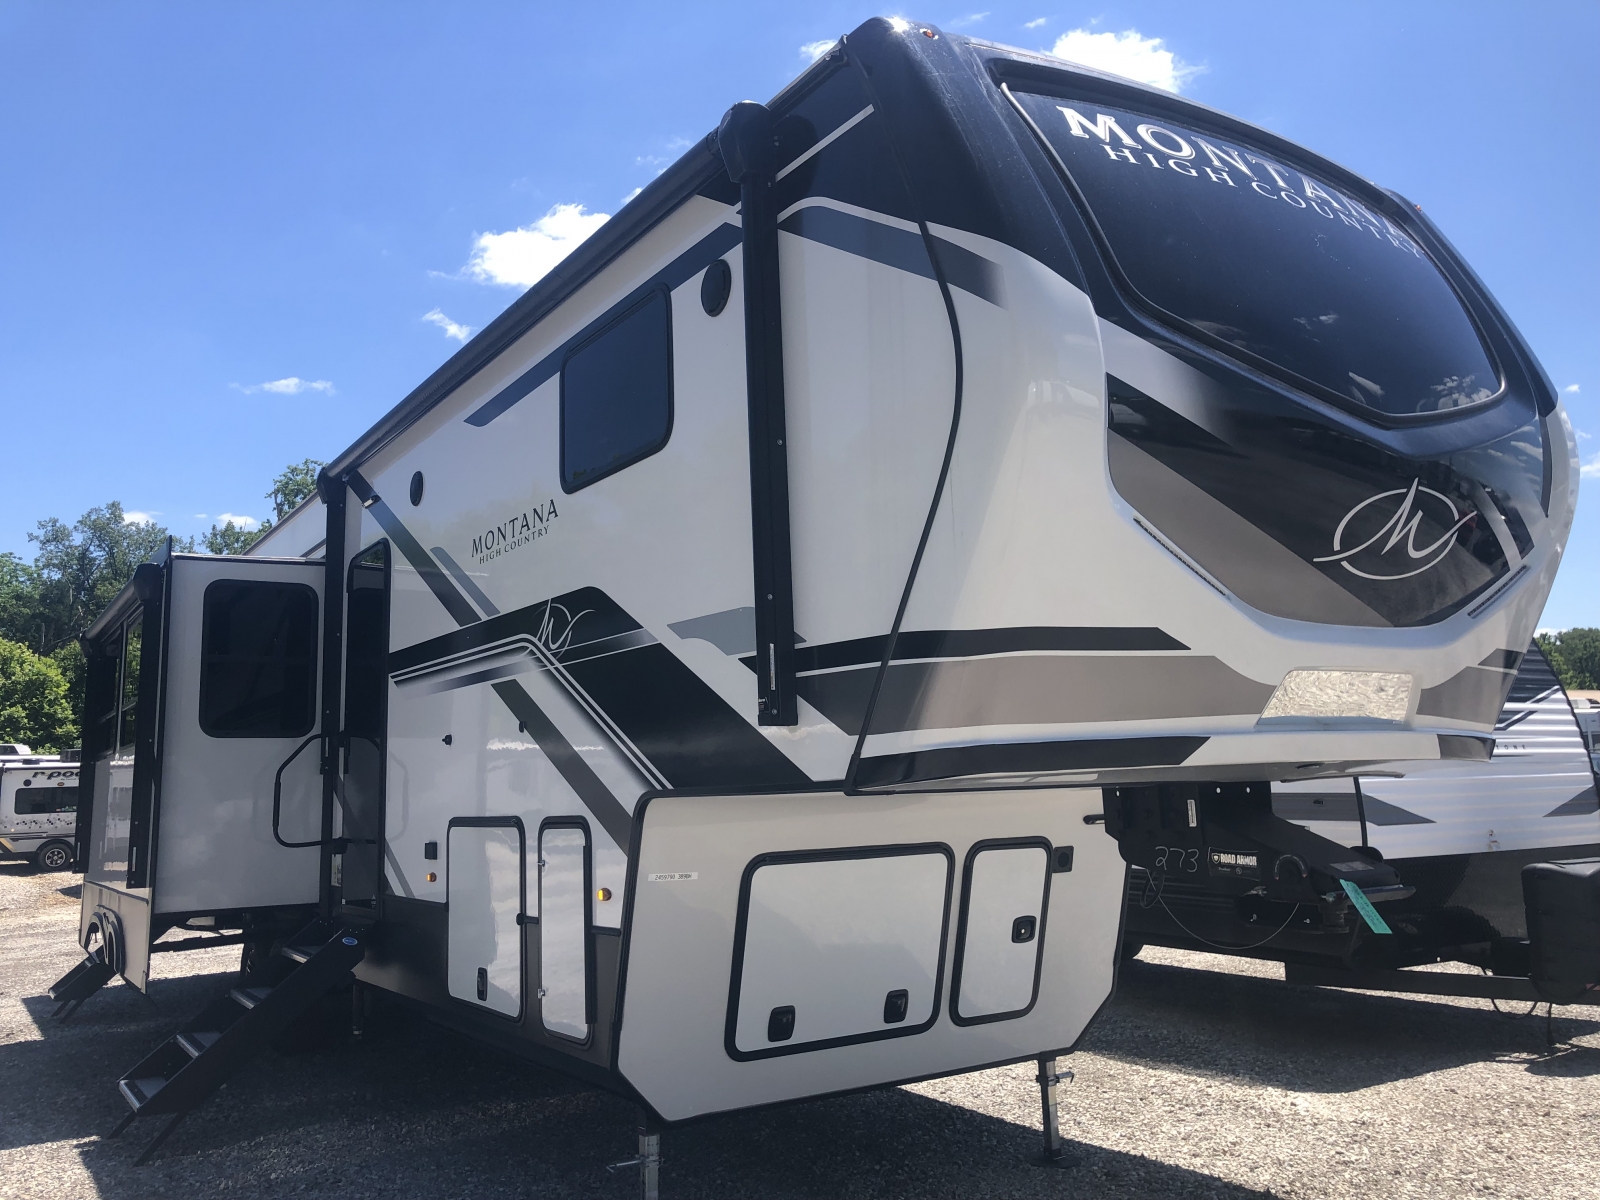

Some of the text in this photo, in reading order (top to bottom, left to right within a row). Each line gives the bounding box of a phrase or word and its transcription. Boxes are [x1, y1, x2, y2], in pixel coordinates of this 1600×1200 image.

[1099, 143, 1421, 259] HIGH COUNTRY
[471, 498, 559, 558] MONTANA
[479, 524, 550, 565] HIGH COUNTRY
[1155, 846, 1200, 873] 273
[1220, 853, 1258, 867] ROAD ARMOR
